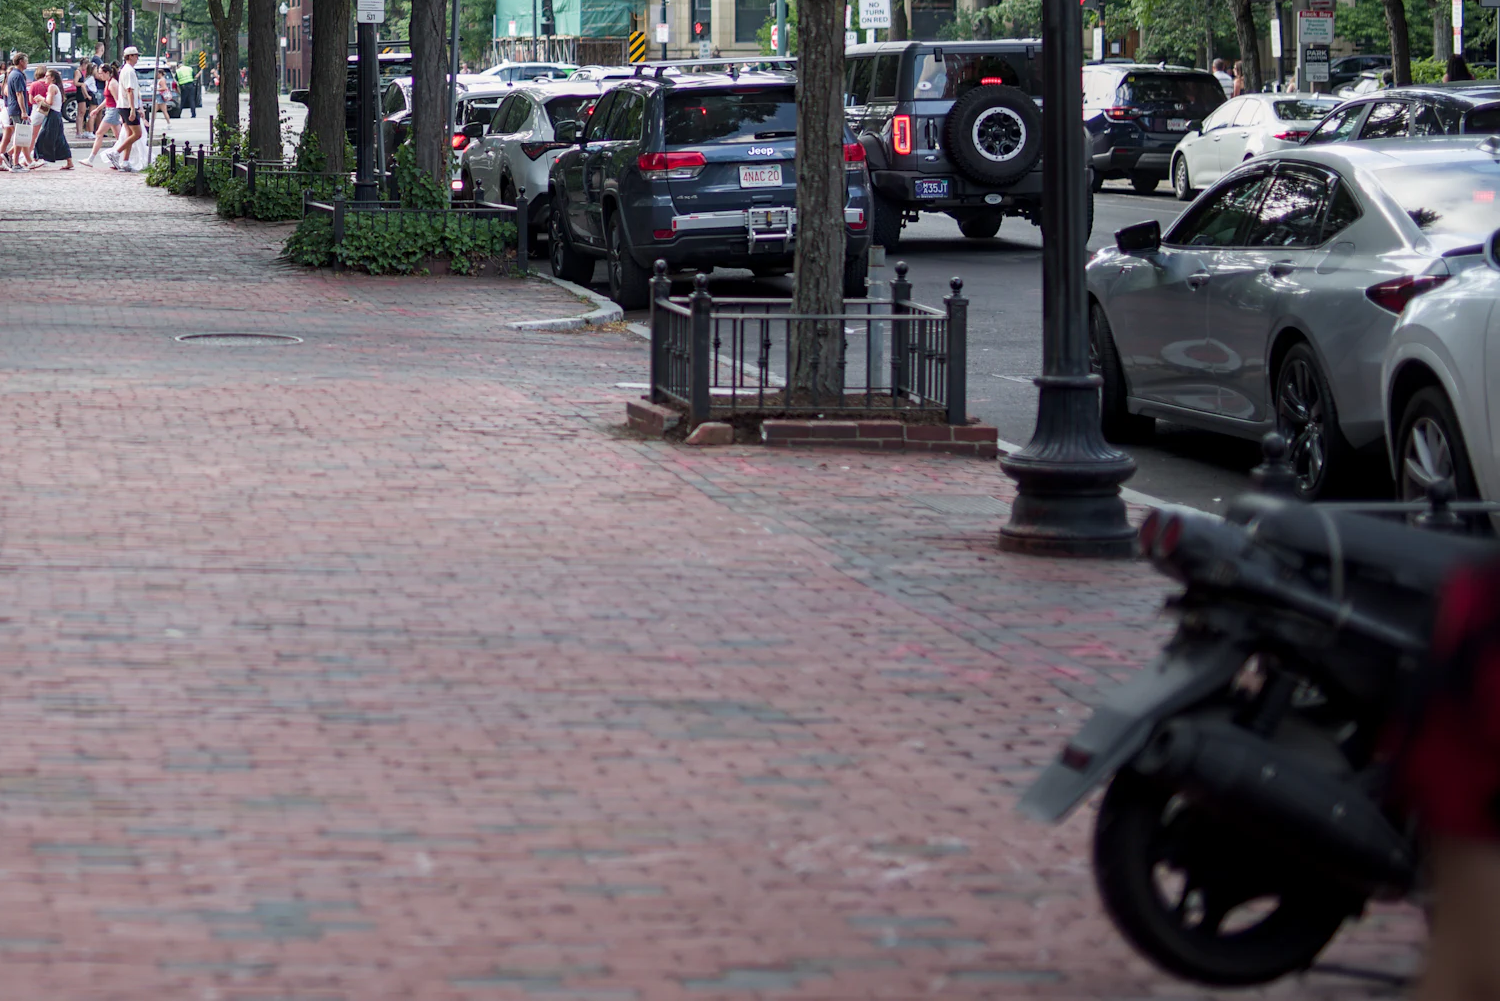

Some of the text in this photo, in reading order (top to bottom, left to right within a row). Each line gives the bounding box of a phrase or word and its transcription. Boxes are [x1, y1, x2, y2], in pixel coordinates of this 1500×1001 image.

[748, 147, 774, 156] Jeep
[743, 171, 779, 181] 4NAC 20
